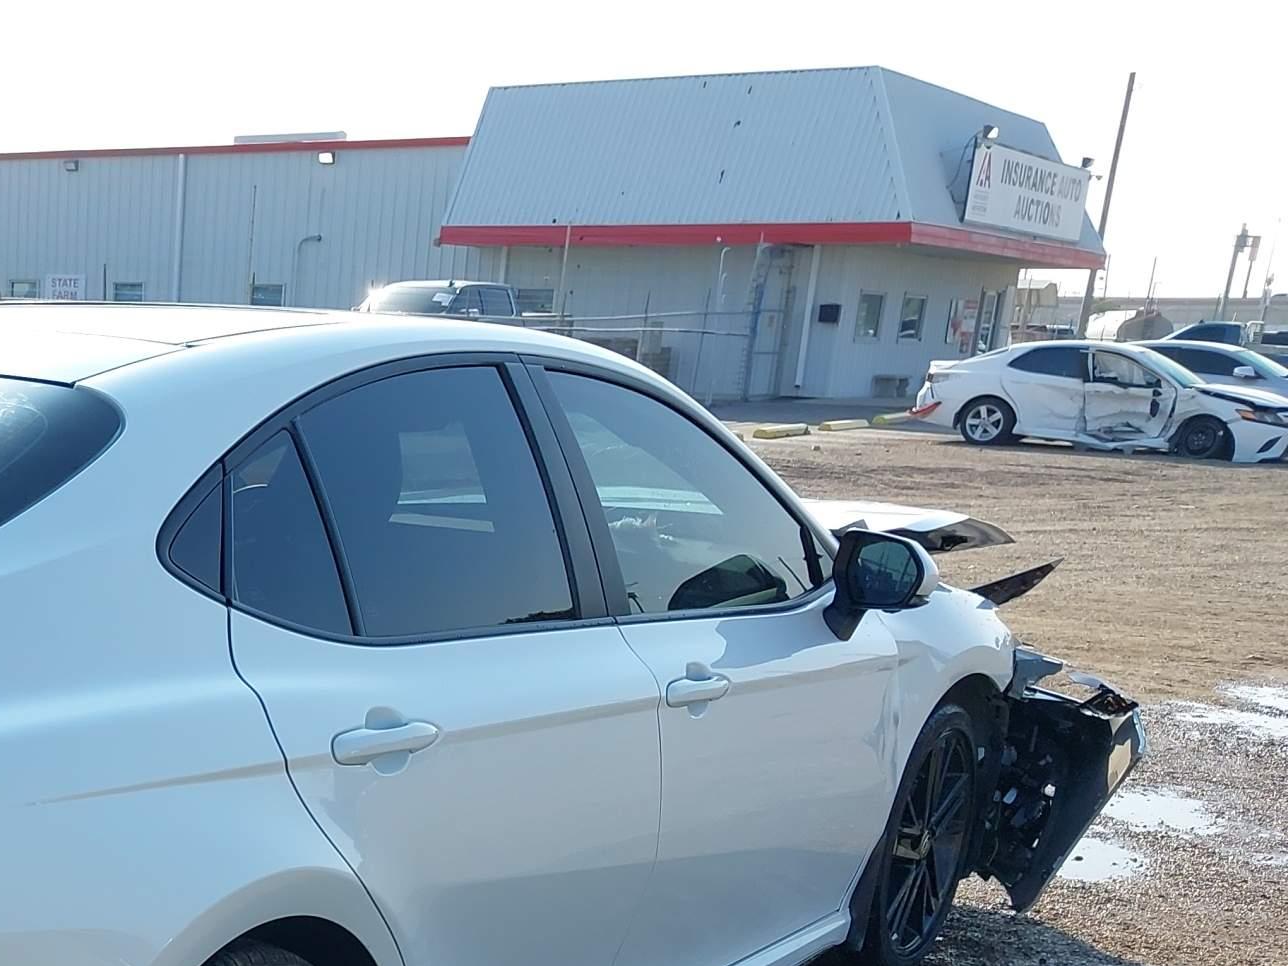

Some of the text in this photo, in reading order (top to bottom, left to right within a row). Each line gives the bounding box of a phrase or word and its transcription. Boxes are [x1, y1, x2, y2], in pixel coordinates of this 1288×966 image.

[1000, 158, 1083, 202] INSURANCE AUTO
[1013, 194, 1062, 228] AUCTIONS
[51, 277, 80, 289] STATE
[52, 291, 78, 301] FARM
